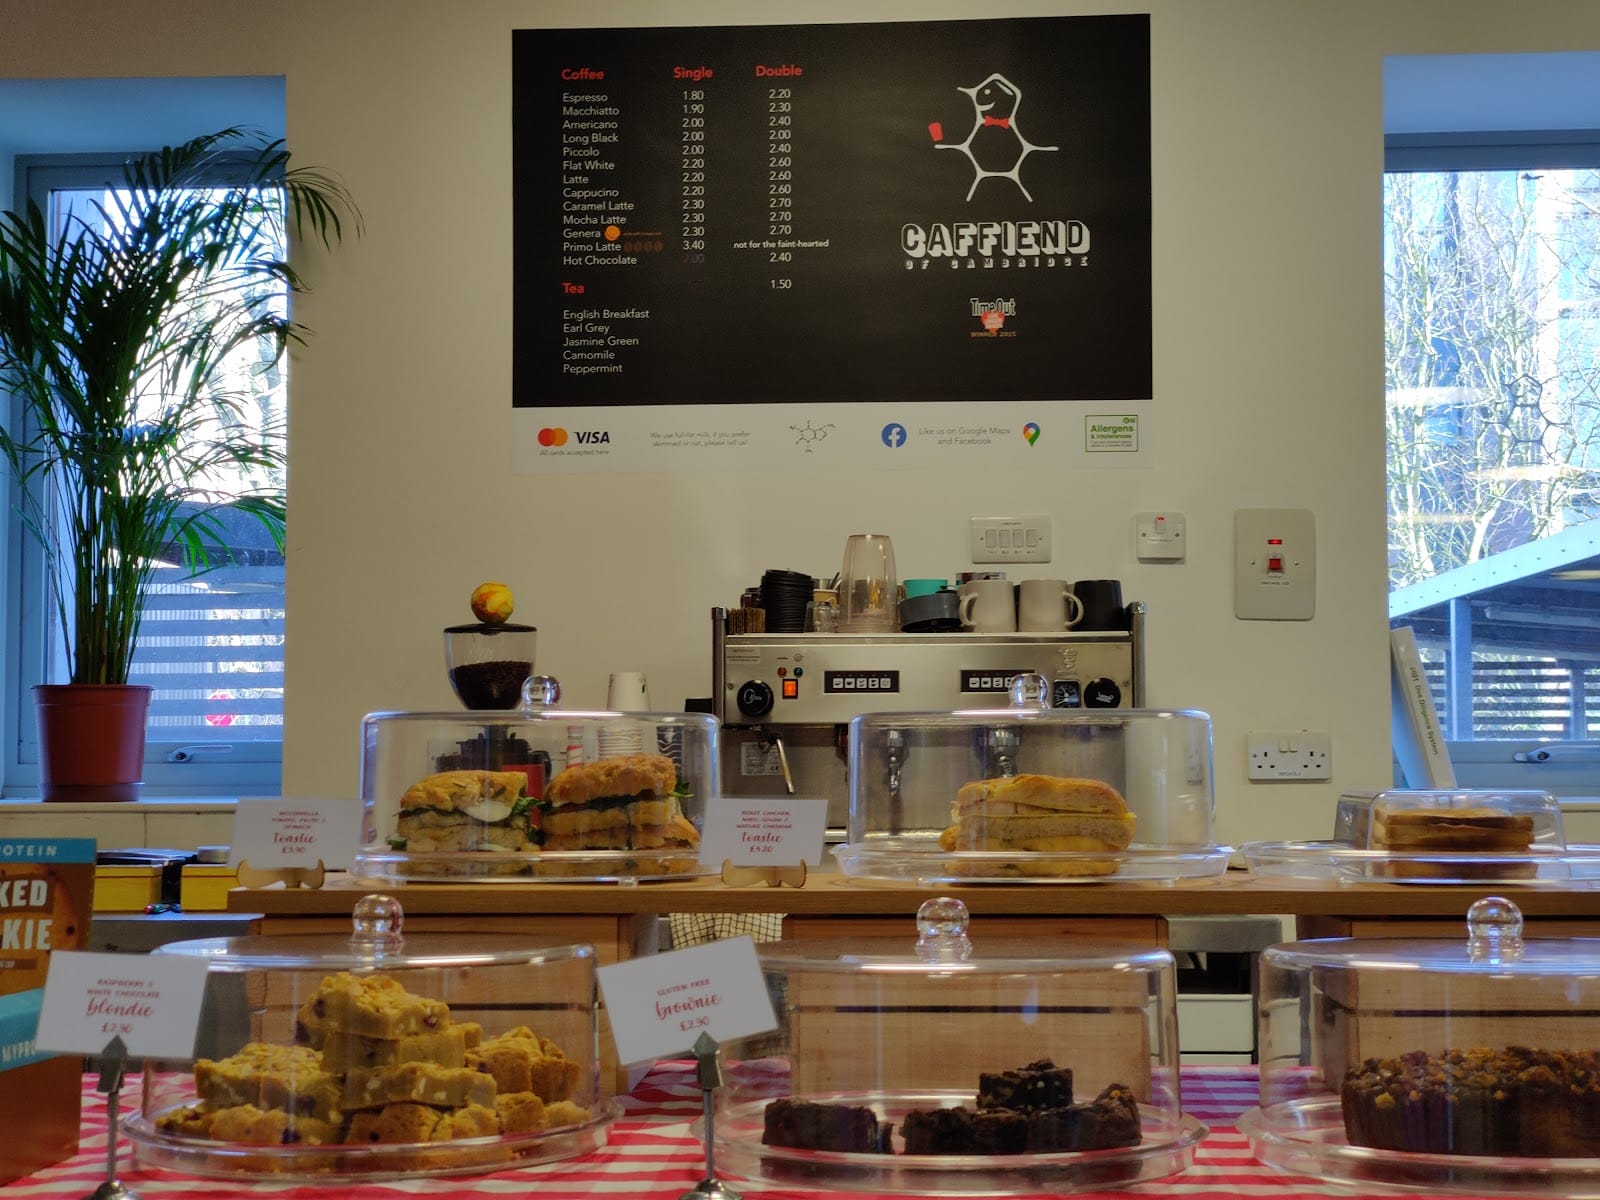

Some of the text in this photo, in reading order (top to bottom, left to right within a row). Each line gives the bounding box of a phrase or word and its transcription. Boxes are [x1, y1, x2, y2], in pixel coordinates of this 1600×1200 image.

[562, 68, 605, 80] Coffee
[673, 66, 714, 81] Single
[755, 64, 803, 77] Double
[562, 92, 608, 104] Espresso
[682, 90, 704, 100] 1.80
[769, 89, 792, 99] 2.20
[562, 105, 620, 116] Macchiatto
[682, 104, 704, 114] 1.90
[769, 102, 792, 112] 2.30
[562, 119, 618, 129] Americano
[682, 118, 704, 127] 2.00
[769, 116, 792, 126] 2.40
[563, 133, 619, 145] Long Black
[682, 131, 704, 141] 2.00
[769, 130, 792, 140] 2.00
[563, 147, 600, 157] Piccolo
[682, 145, 704, 155] 2.00
[769, 143, 792, 153] 2.40
[563, 160, 615, 170] Flat White
[682, 159, 704, 168] 2.20
[769, 157, 792, 167] 2.60
[563, 174, 589, 184] Latte
[682, 172, 704, 182] 2.20
[769, 171, 792, 181] 2.60
[563, 188, 619, 199] Cappucino
[682, 186, 704, 196] 2.20
[769, 184, 792, 194] 2.60
[563, 201, 634, 211] Caramel Latte
[682, 199, 704, 209] 2.30
[769, 198, 792, 208] 2.70
[563, 215, 626, 225] Mocha Latte
[682, 213, 704, 223] 2.30
[769, 211, 792, 221] 2.70
[563, 228, 601, 238] Genera
[682, 227, 704, 236] 2.30
[769, 225, 792, 235] 2.70
[902, 220, 1090, 258] CAFFIEND
[563, 242, 622, 252] Primo Latte
[682, 240, 704, 250] 3.40
[763, 240, 776, 248] the
[778, 240, 829, 249] faint-hearted
[563, 255, 638, 265] Hot Chocolate
[769, 252, 792, 262] 2.40
[562, 282, 585, 294] Tea
[769, 280, 792, 288] 1.50
[563, 308, 650, 321] English Breakfast
[563, 323, 610, 334] Earl Grey
[563, 336, 639, 347] Jasmine Green
[563, 350, 615, 360] Camomile
[563, 364, 623, 375] Peppermint
[958, 427, 987, 437] Google
[989, 427, 1010, 436] Maps
[1090, 425, 1134, 434] Allergens
[574, 431, 610, 444] VISA
[955, 437, 991, 445] Facebook
[1414, 685, 1422, 699] Due
[1418, 699, 1431, 730] Diligence
[1428, 730, 1439, 755] System
[0, 844, 57, 857] OTEIN
[656, 978, 711, 996] GLUTEN FREE
[86, 997, 154, 1017] blondie
[655, 993, 721, 1020] brownie
